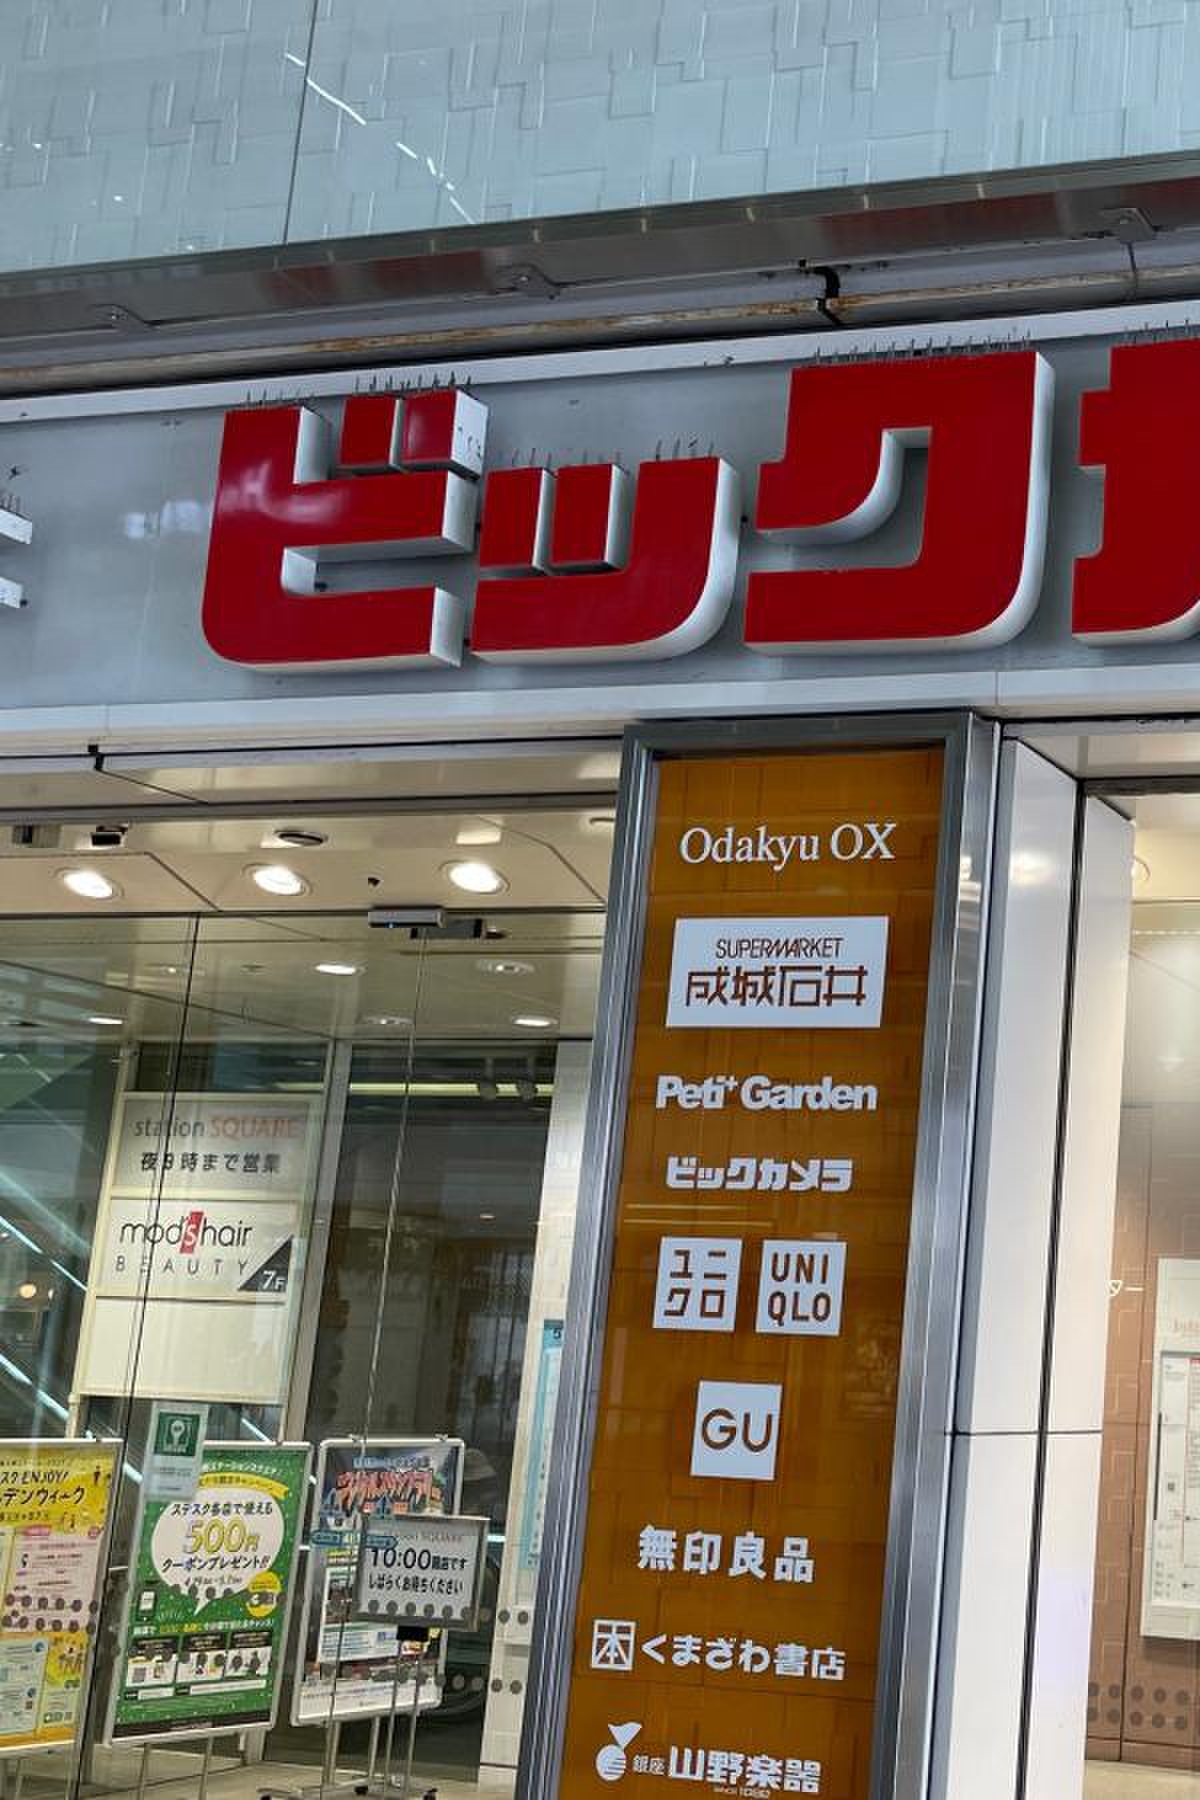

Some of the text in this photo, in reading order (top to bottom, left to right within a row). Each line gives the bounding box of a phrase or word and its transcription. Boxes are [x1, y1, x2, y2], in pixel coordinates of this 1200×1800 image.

[680, 822, 898, 872] Odakyu OX
[715, 937, 844, 960] SUPERMARKET
[685, 965, 868, 1008] 成城石井
[740, 1075, 878, 1110] Garden
[665, 1155, 854, 1193] ビックカメラ
[261, 1270, 286, 1291] 7F
[770, 1251, 830, 1285] UNI
[766, 1290, 832, 1328] QLO
[701, 1408, 773, 1452] GU
[0, 1486, 85, 1506] デンウィーク
[638, 1524, 815, 1583] 無印良品
[641, 1633, 846, 1681] くまざわ書店
[668, 1745, 822, 1793] 山野楽器
